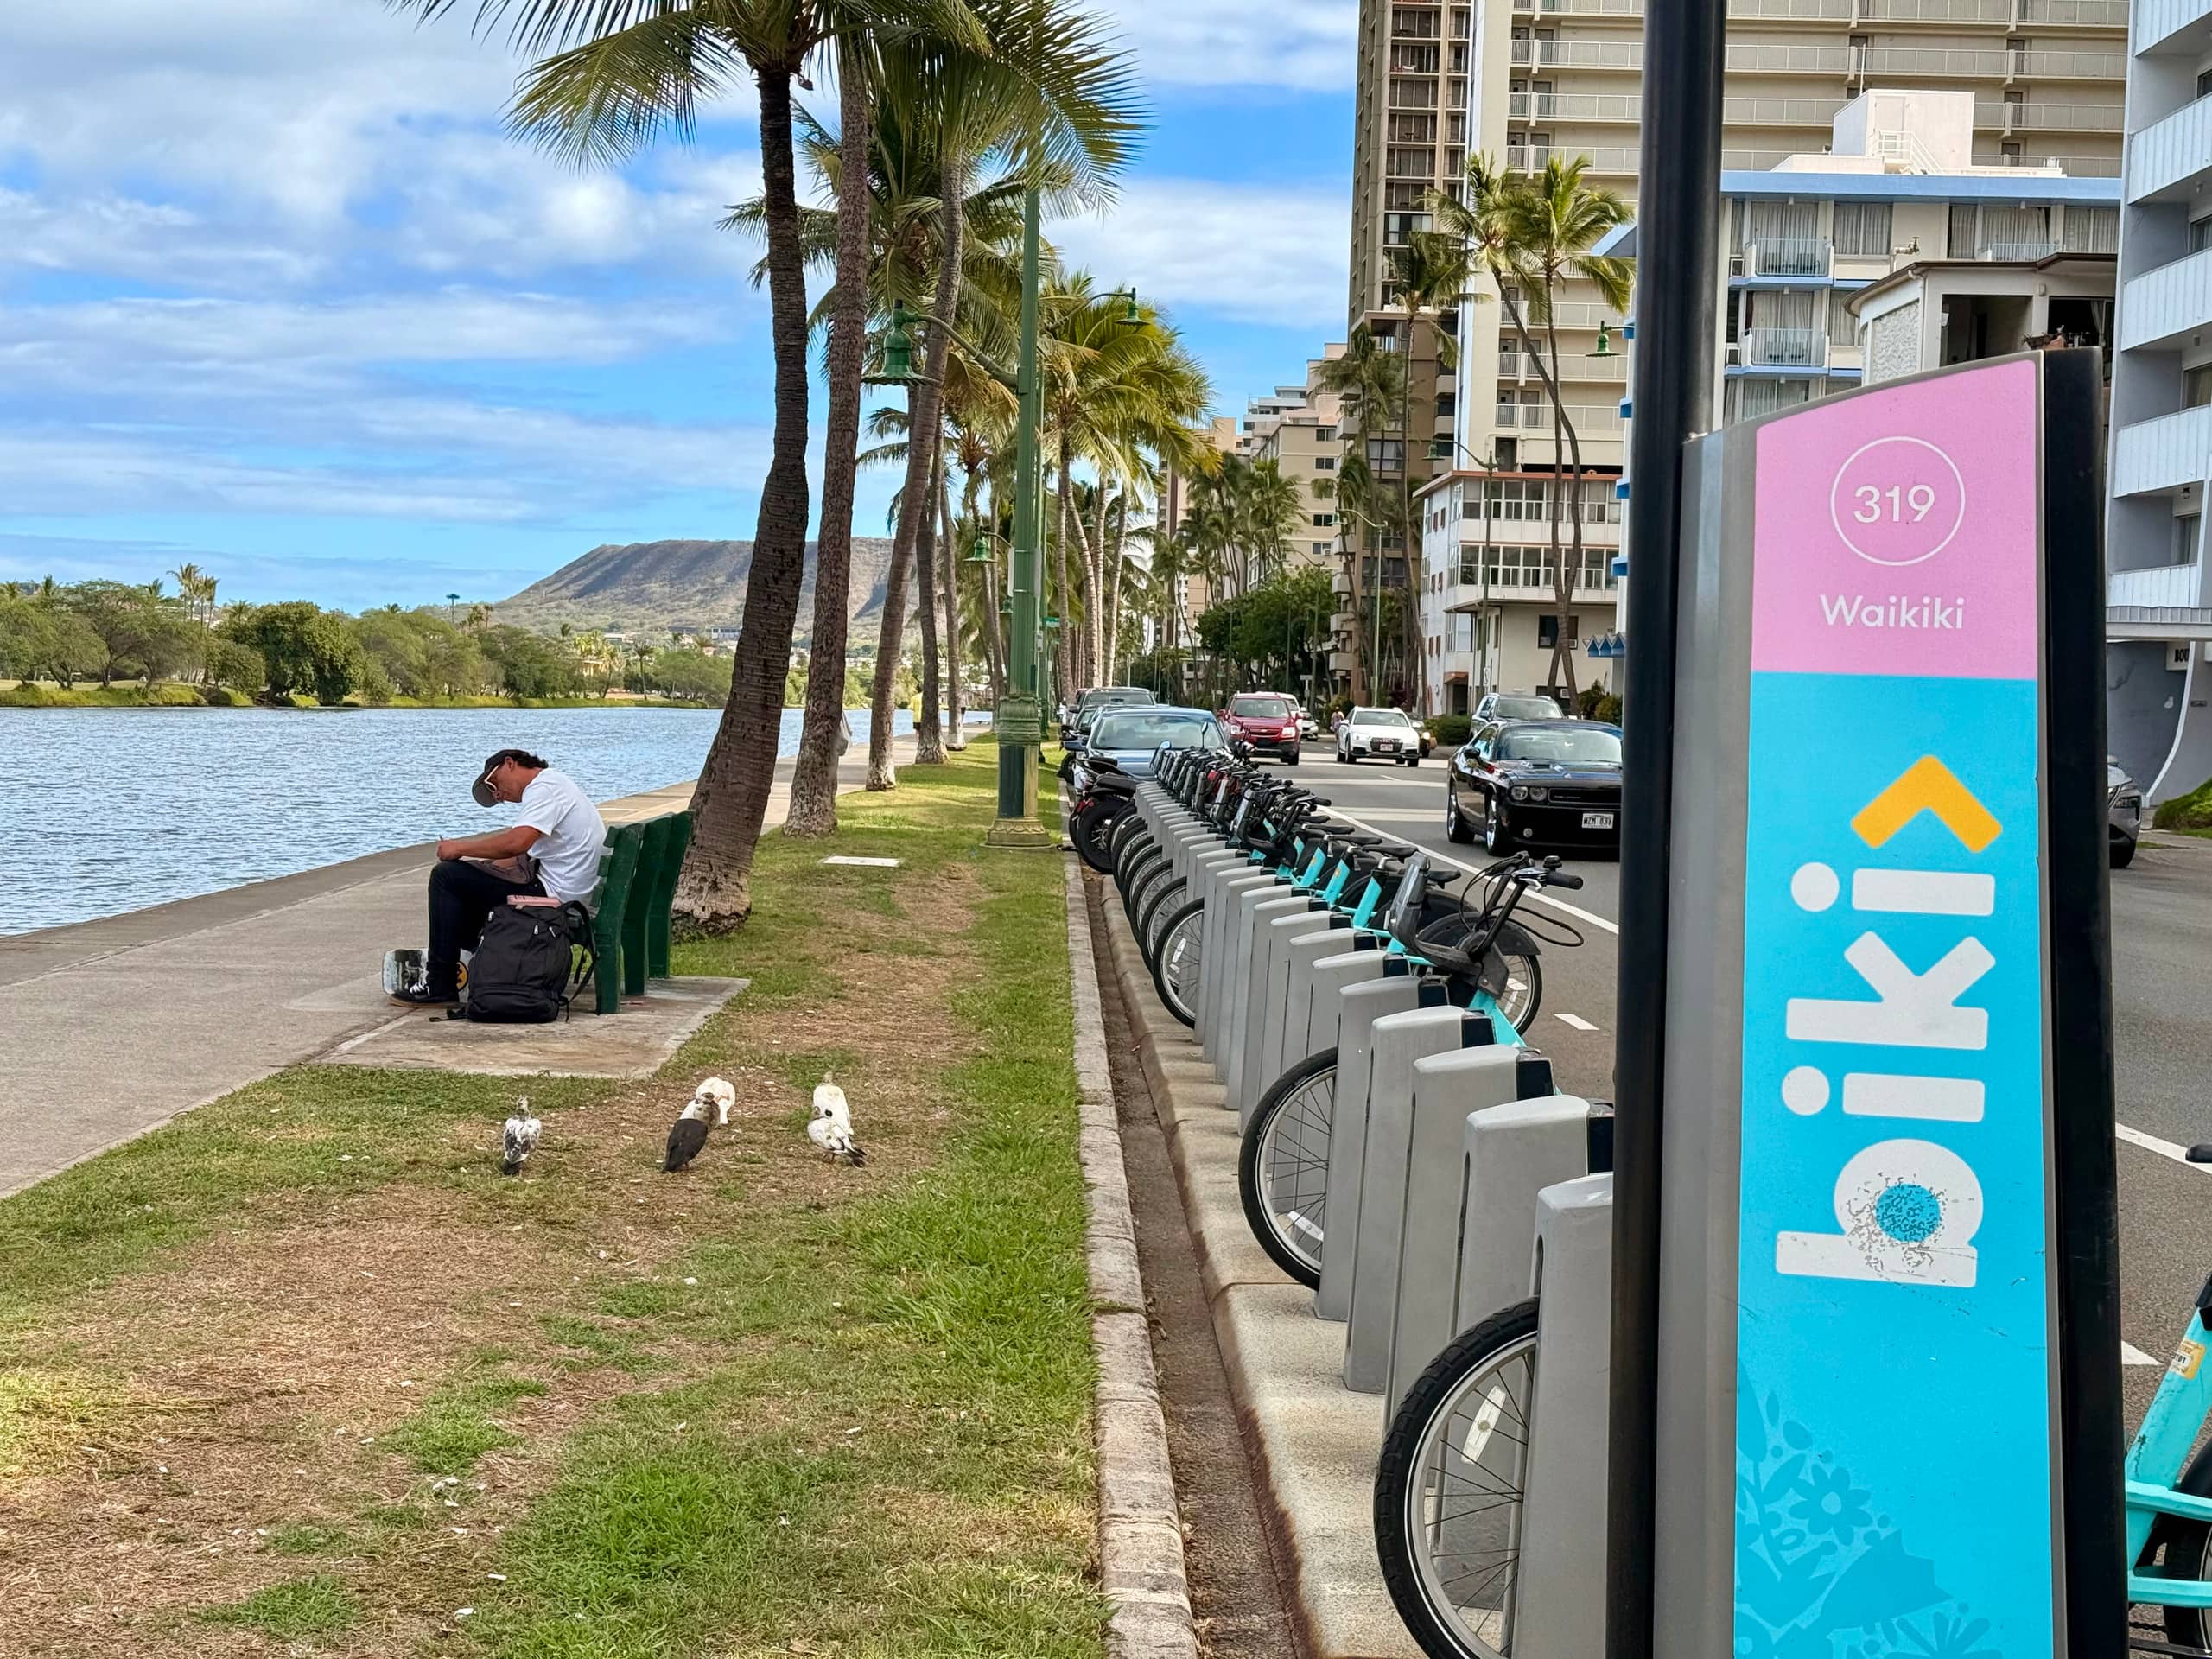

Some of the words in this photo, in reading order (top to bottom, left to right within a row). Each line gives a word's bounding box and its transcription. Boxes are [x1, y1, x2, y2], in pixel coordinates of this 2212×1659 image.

[1853, 484, 1936, 524] 319
[1820, 594, 1966, 630] Waikiki
[1776, 861, 1997, 1288] biki
